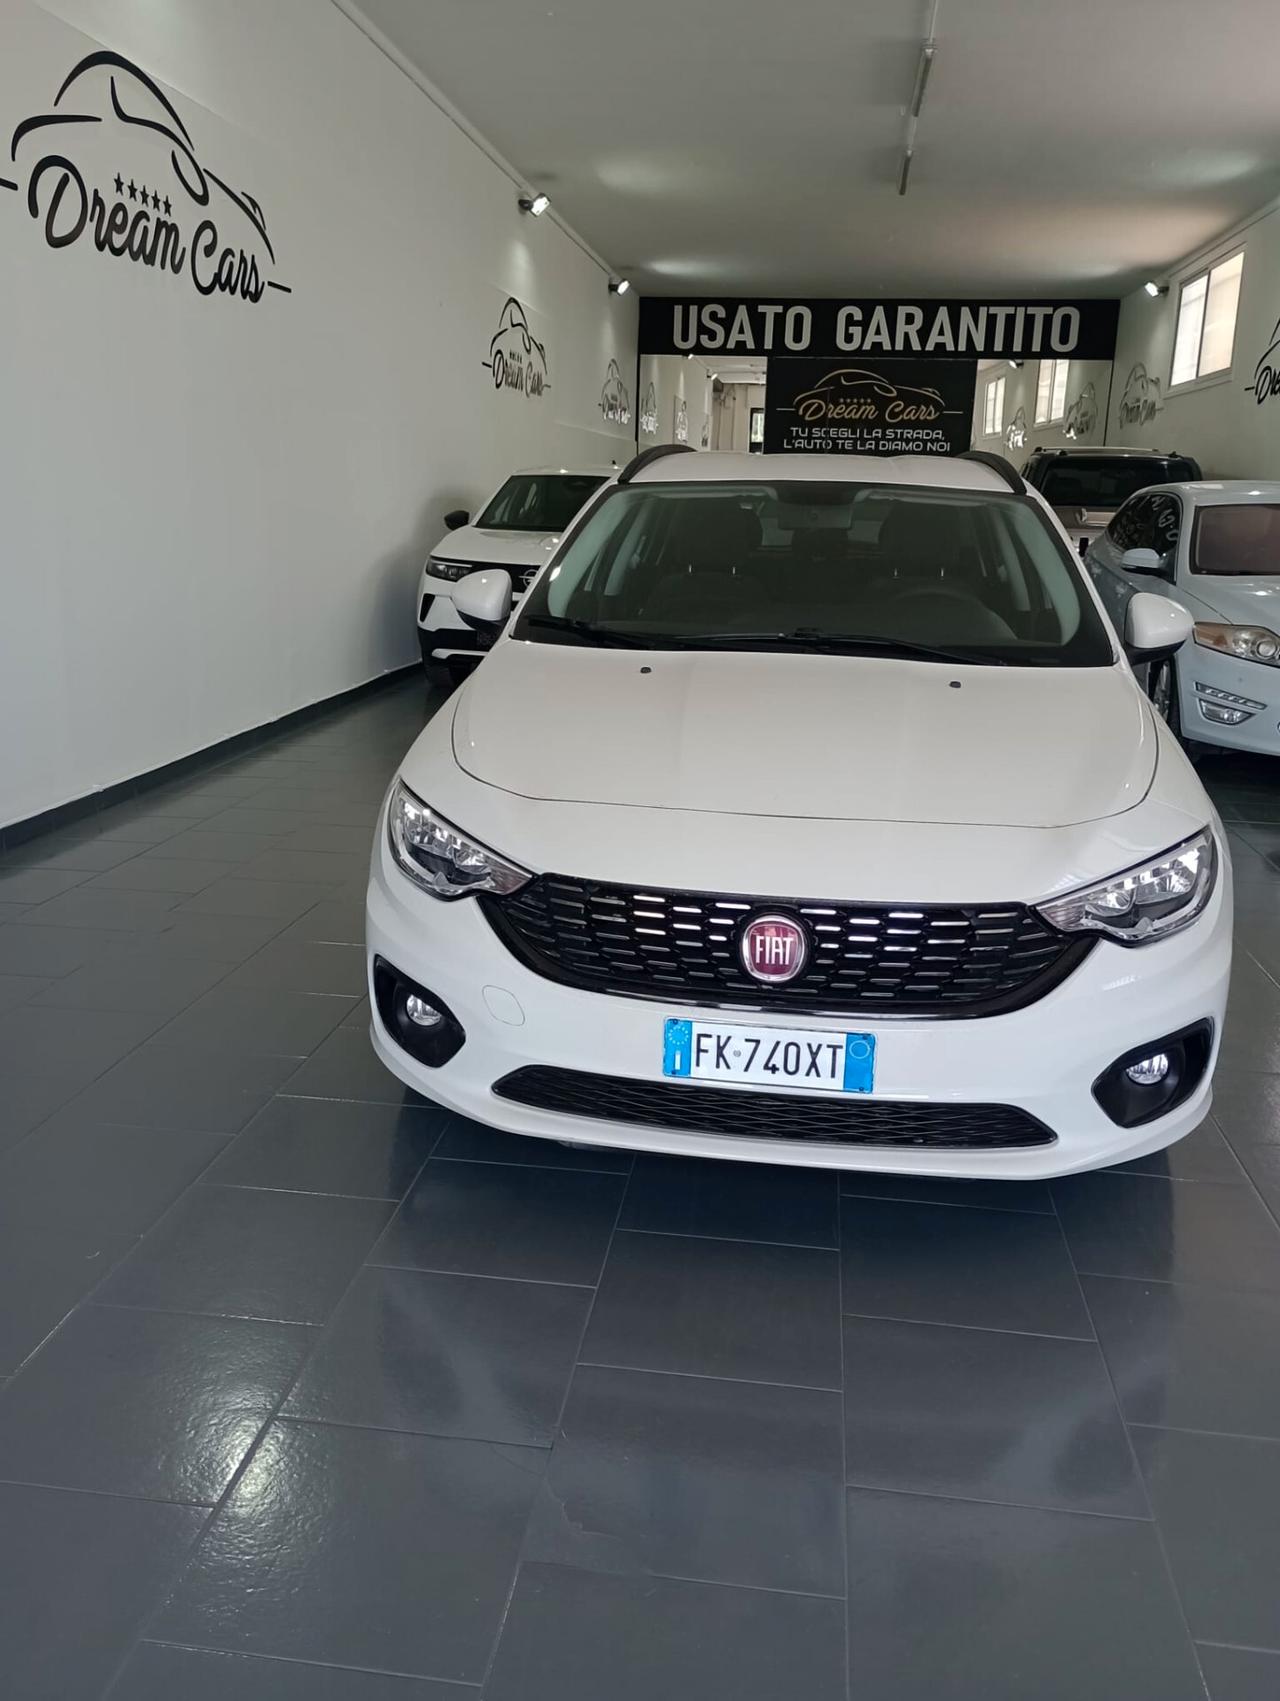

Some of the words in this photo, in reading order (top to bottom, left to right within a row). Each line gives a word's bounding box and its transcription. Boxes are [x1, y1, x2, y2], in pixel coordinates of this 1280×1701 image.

[28, 155, 187, 275] Dream
[191, 220, 265, 303] Cars
[673, 303, 812, 350] USATO
[836, 305, 1081, 353] GARANTITO
[798, 399, 879, 421] Dream
[885, 401, 940, 423] Cars
[783, 439, 832, 450] L'AUTO
[836, 440, 853, 450] TE
[856, 440, 875, 451] LA
[878, 441, 923, 452] DIAMO
[926, 442, 951, 452] NOI
[790, 427, 808, 437] TU
[811, 427, 860, 438] SCEGLI
[863, 428, 882, 439] LA
[885, 429, 945, 440] STRADA,
[755, 935, 794, 966] FIAT
